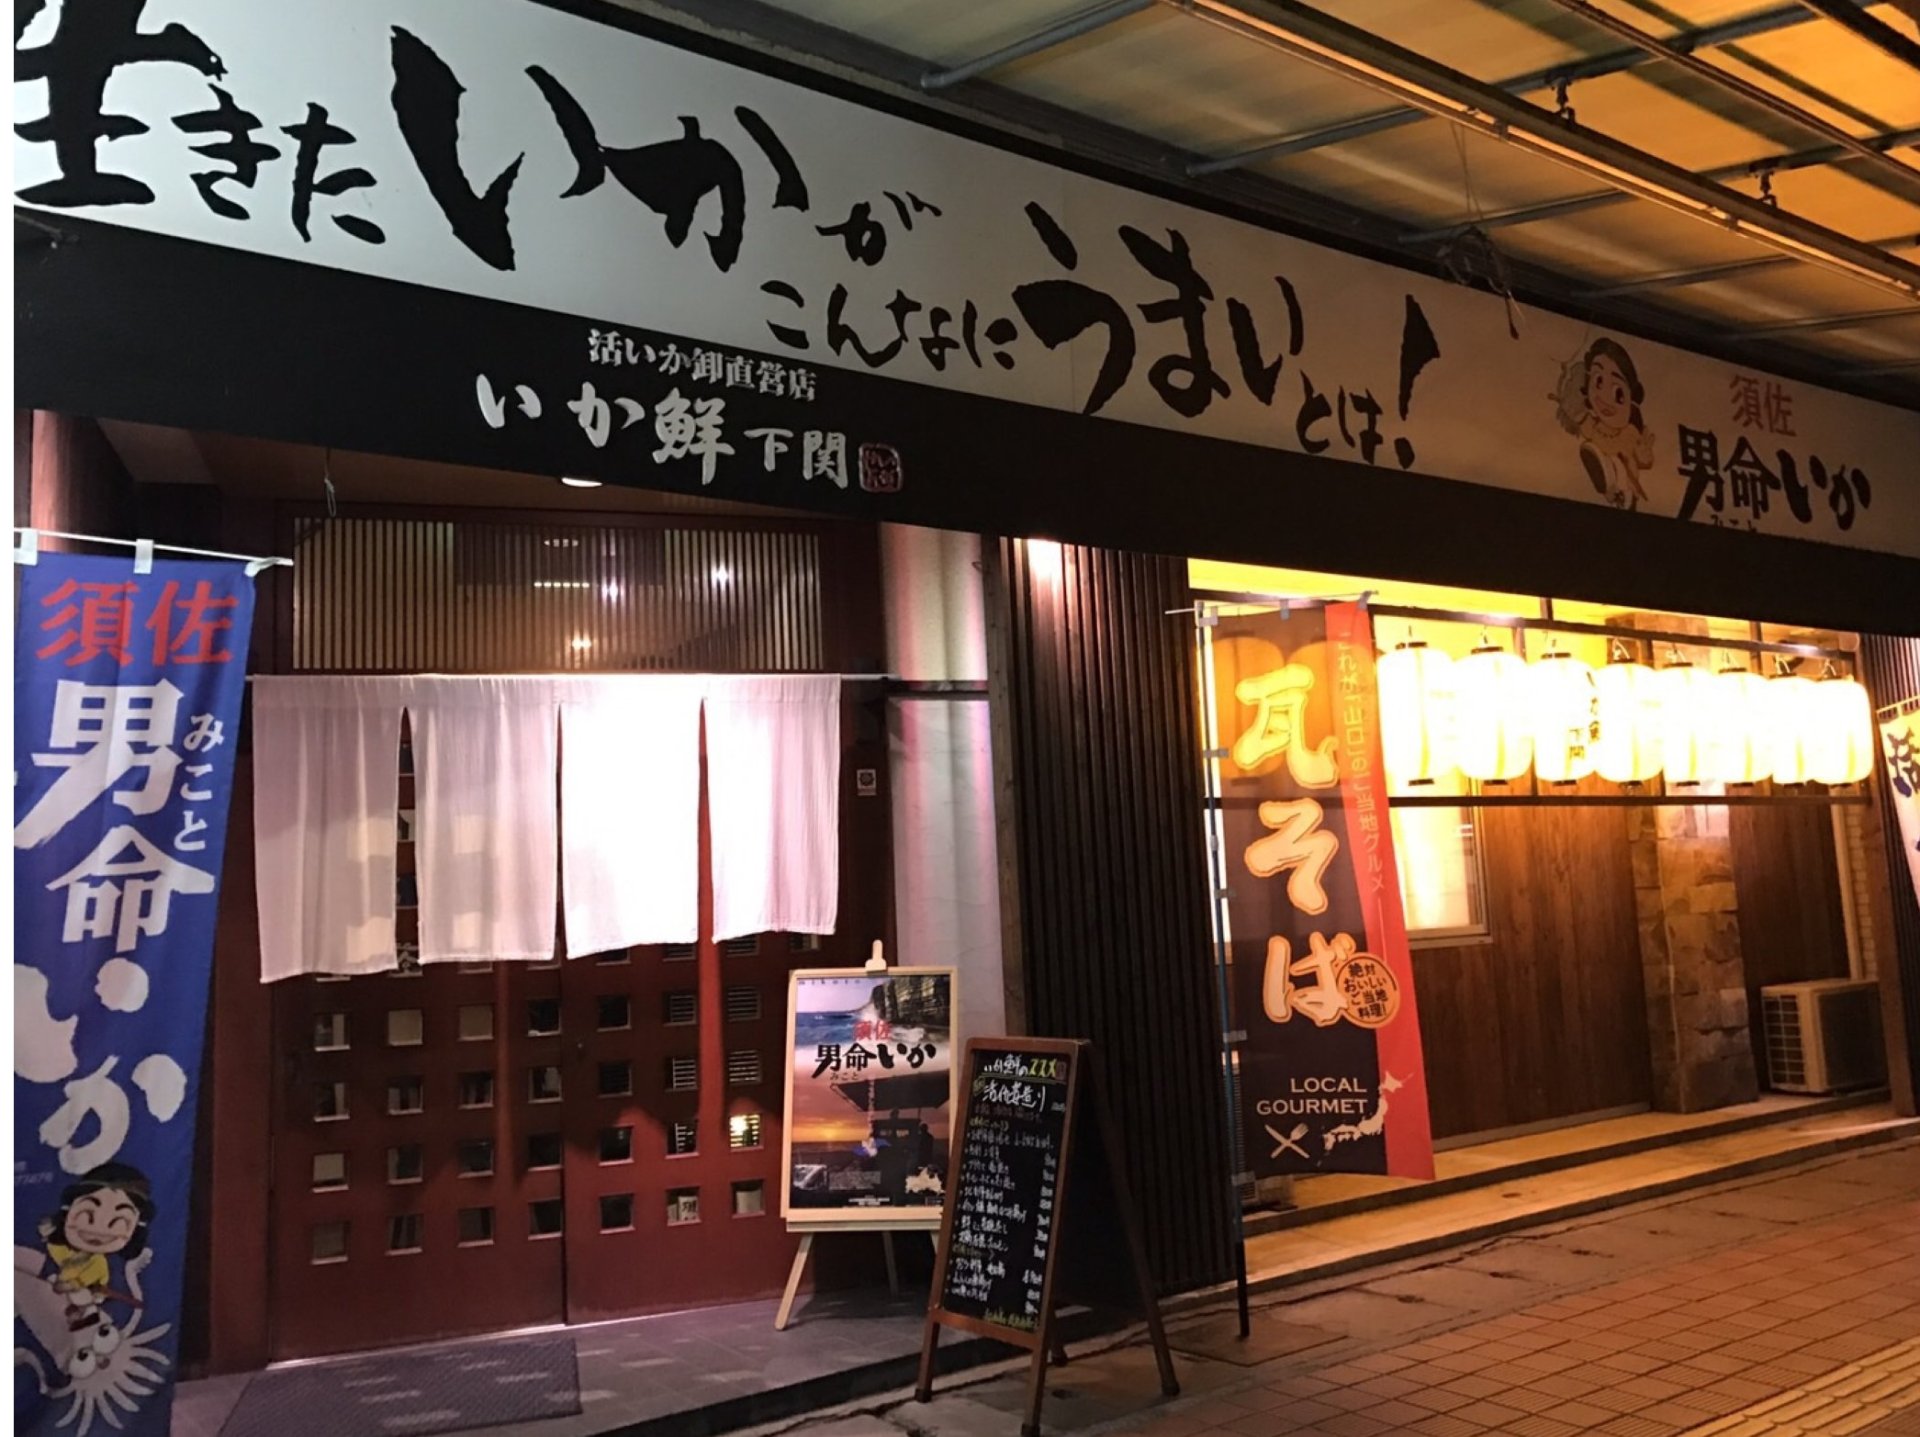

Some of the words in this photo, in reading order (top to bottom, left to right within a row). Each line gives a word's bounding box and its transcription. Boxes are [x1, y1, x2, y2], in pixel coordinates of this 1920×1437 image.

[588, 328, 817, 402] 活いか卸直営店
[1729, 373, 1797, 437] 須佐
[1677, 423, 1872, 532] 男命いか
[36, 578, 239, 667] 須佐
[173, 713, 225, 852] みこと
[1233, 663, 1357, 1028] 瓦そば
[811, 1043, 937, 1079] 男命いか
[853, 1020, 893, 1041] 須佐
[830, 1071, 859, 1081] みこと
[1256, 1098, 1368, 1116] GOURMET
[1290, 1076, 1367, 1094] LOCAL
